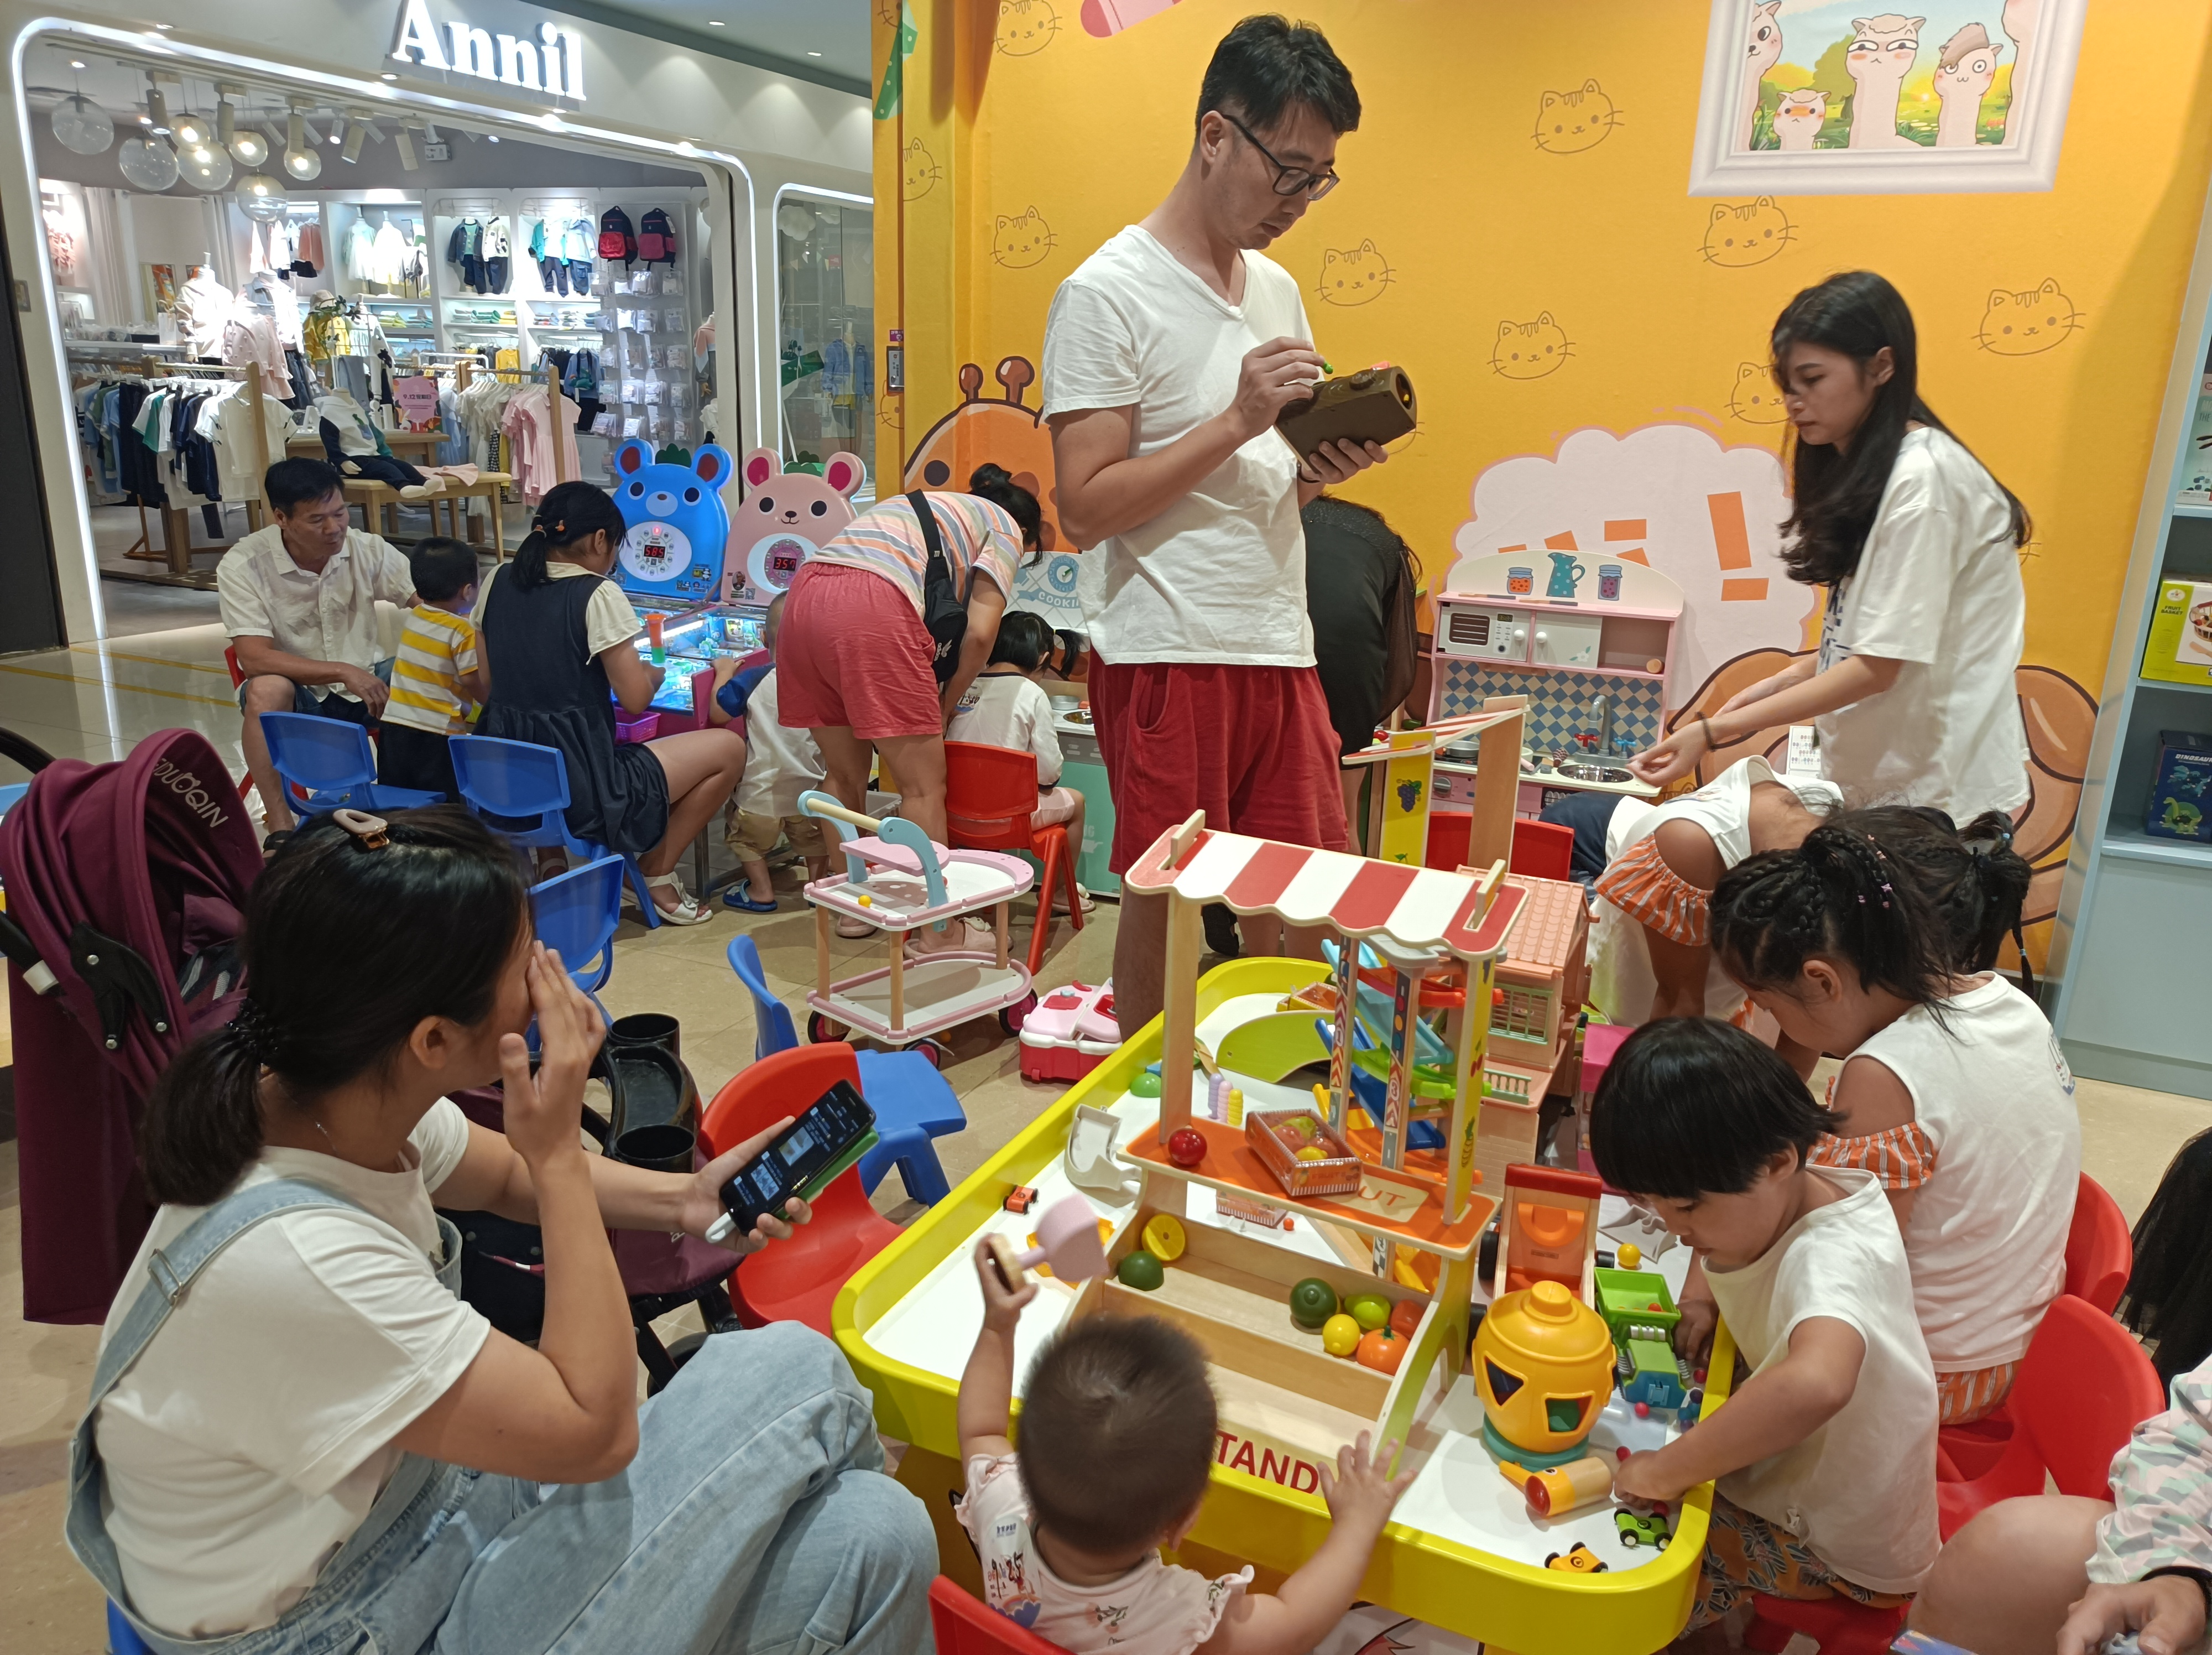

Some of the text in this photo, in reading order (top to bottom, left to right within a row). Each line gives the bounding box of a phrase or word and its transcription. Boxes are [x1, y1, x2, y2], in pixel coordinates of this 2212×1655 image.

[392, 0, 587, 101] Annil
[645, 546, 664, 558] 585
[775, 558, 796, 569] 357
[1217, 1429, 1319, 1495] TAND
